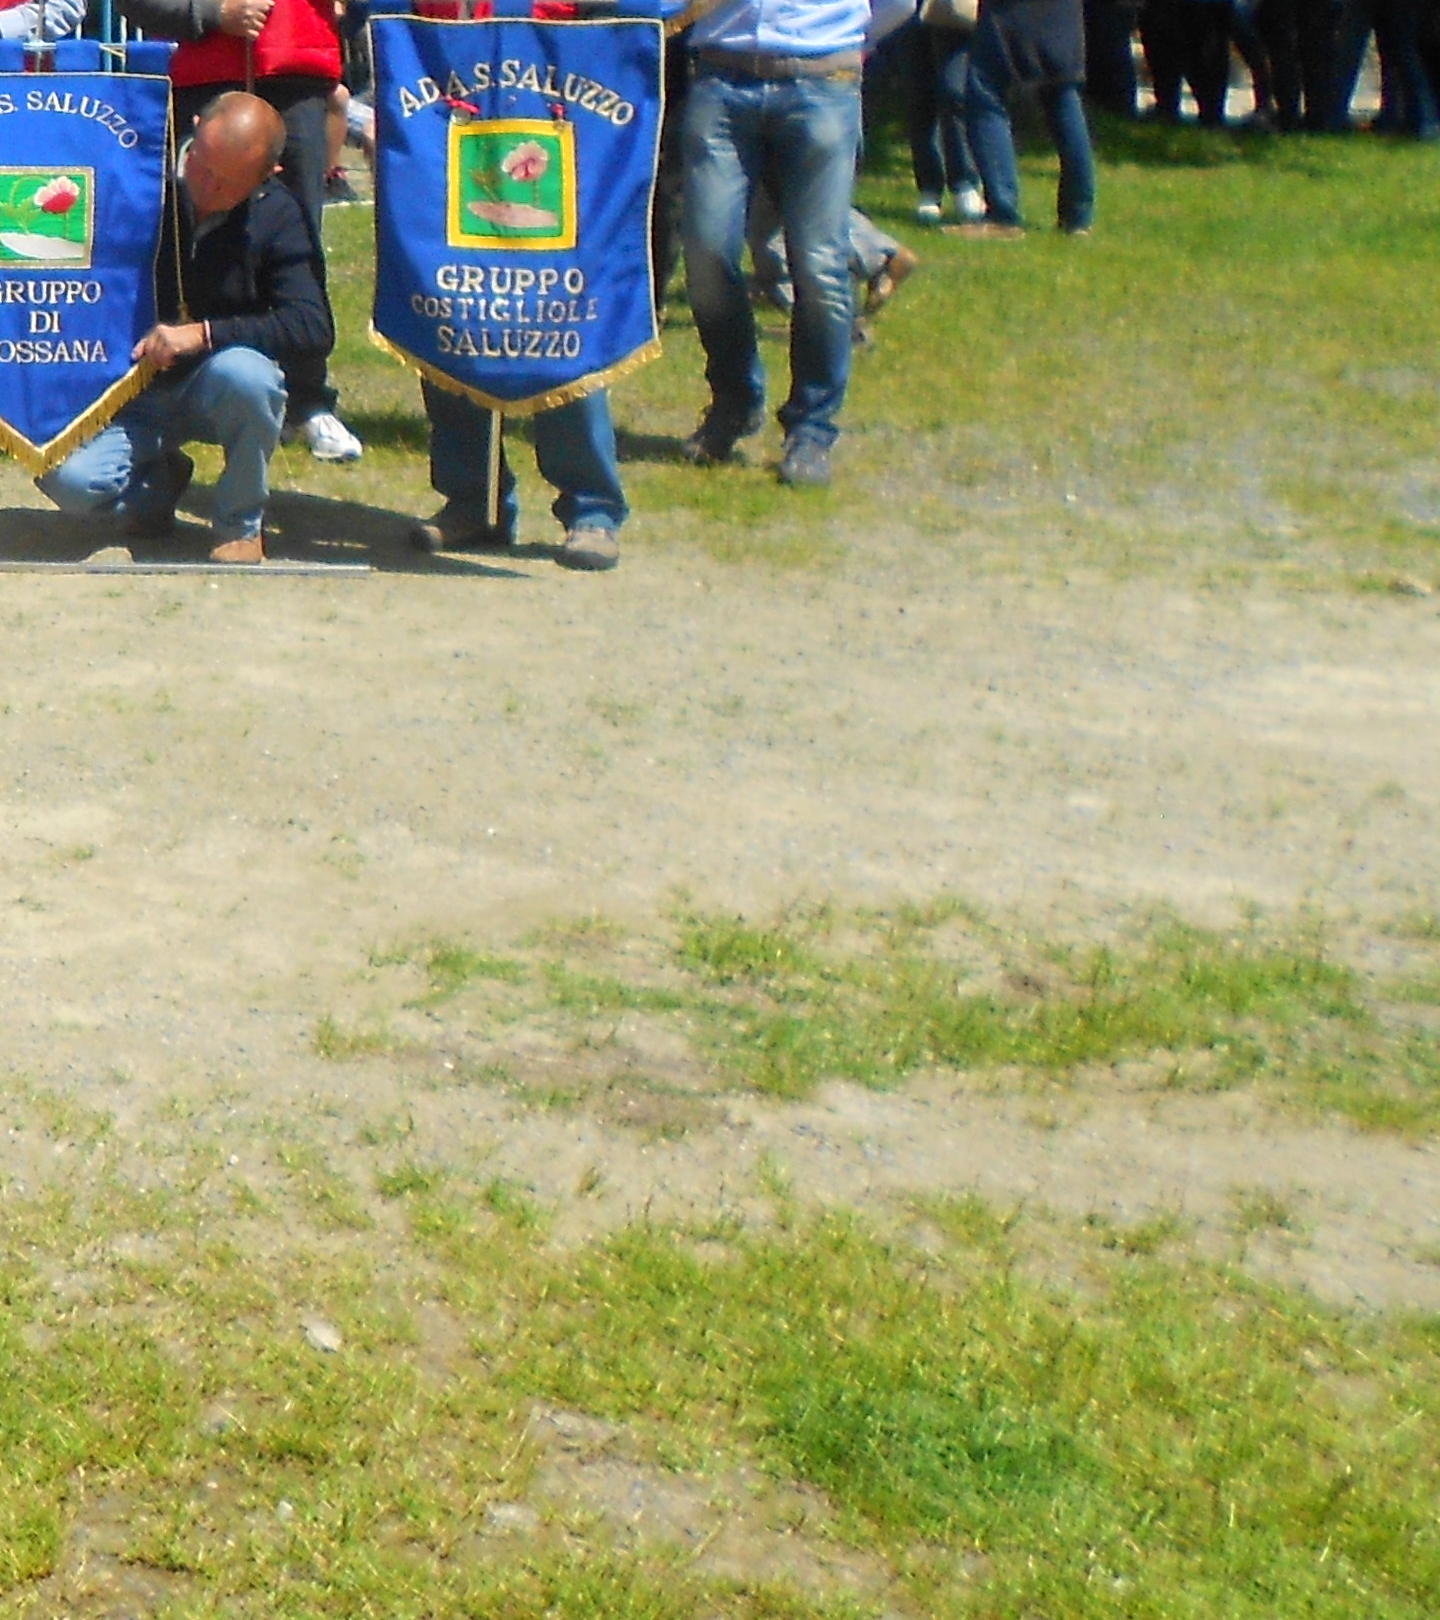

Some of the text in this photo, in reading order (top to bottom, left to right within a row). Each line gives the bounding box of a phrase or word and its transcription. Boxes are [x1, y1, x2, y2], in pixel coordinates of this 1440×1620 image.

[498, 58, 636, 126] SALUZZO
[26, 90, 140, 150] SALUZZO
[435, 264, 586, 297] GRUPPO
[28, 310, 62, 336] DI
[410, 294, 600, 324] COSTIGLIOLE
[436, 324, 582, 359] SALUZZO
